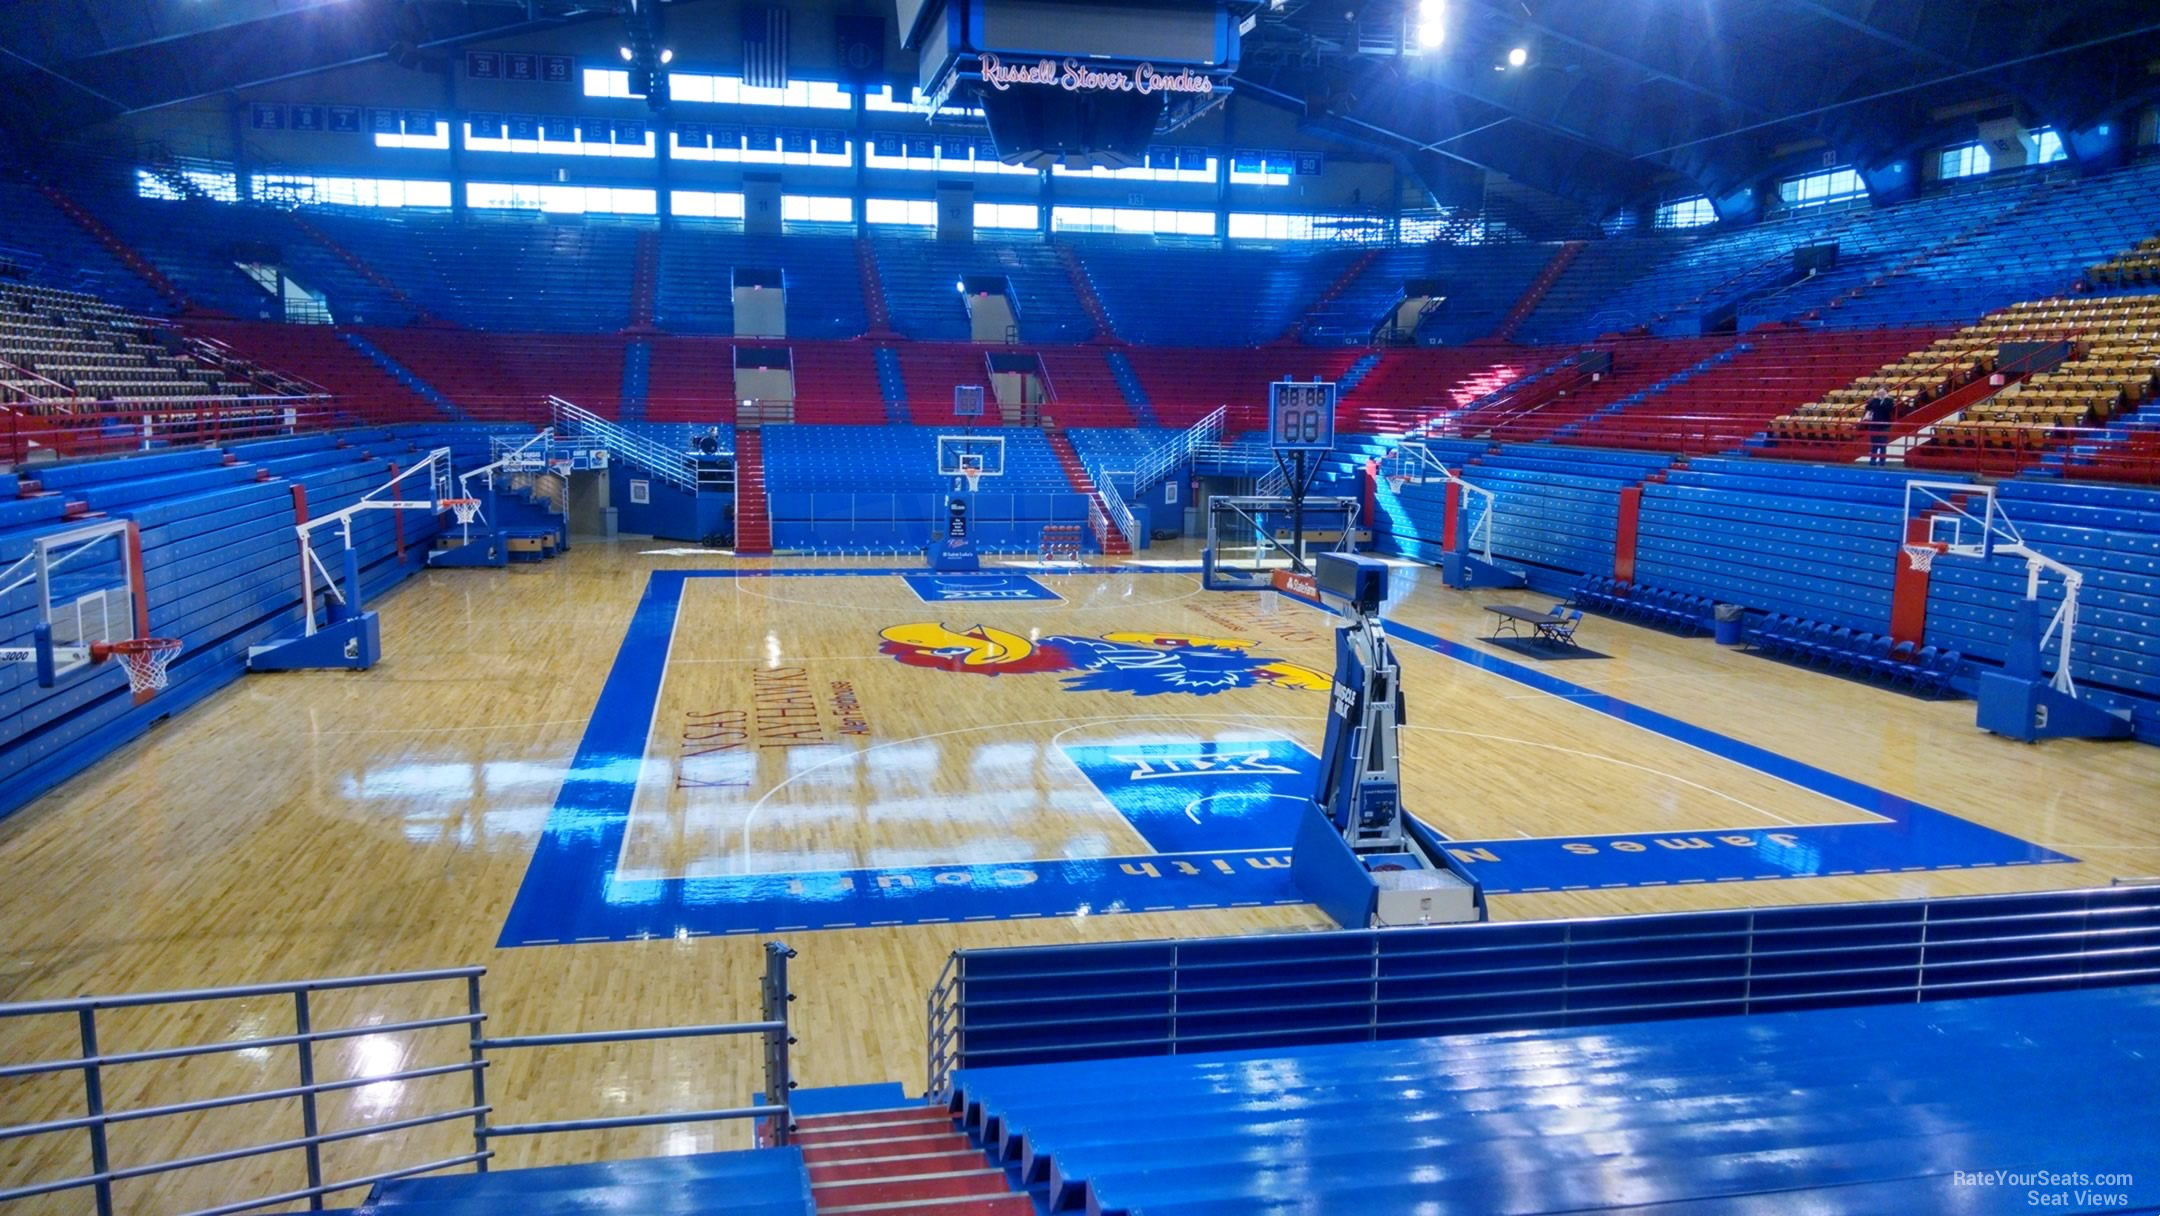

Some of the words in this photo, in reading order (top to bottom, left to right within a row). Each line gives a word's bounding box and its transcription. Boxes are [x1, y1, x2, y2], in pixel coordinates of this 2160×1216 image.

[477, 60, 490, 73] 31
[514, 62, 528, 74] 12
[550, 63, 565, 76] 33
[978, 52, 1058, 91] Russell
[1061, 57, 1133, 91] Stover
[1135, 62, 1213, 95] Candies
[675, 709, 750, 790] KNSAS
[1561, 832, 1802, 855] James
